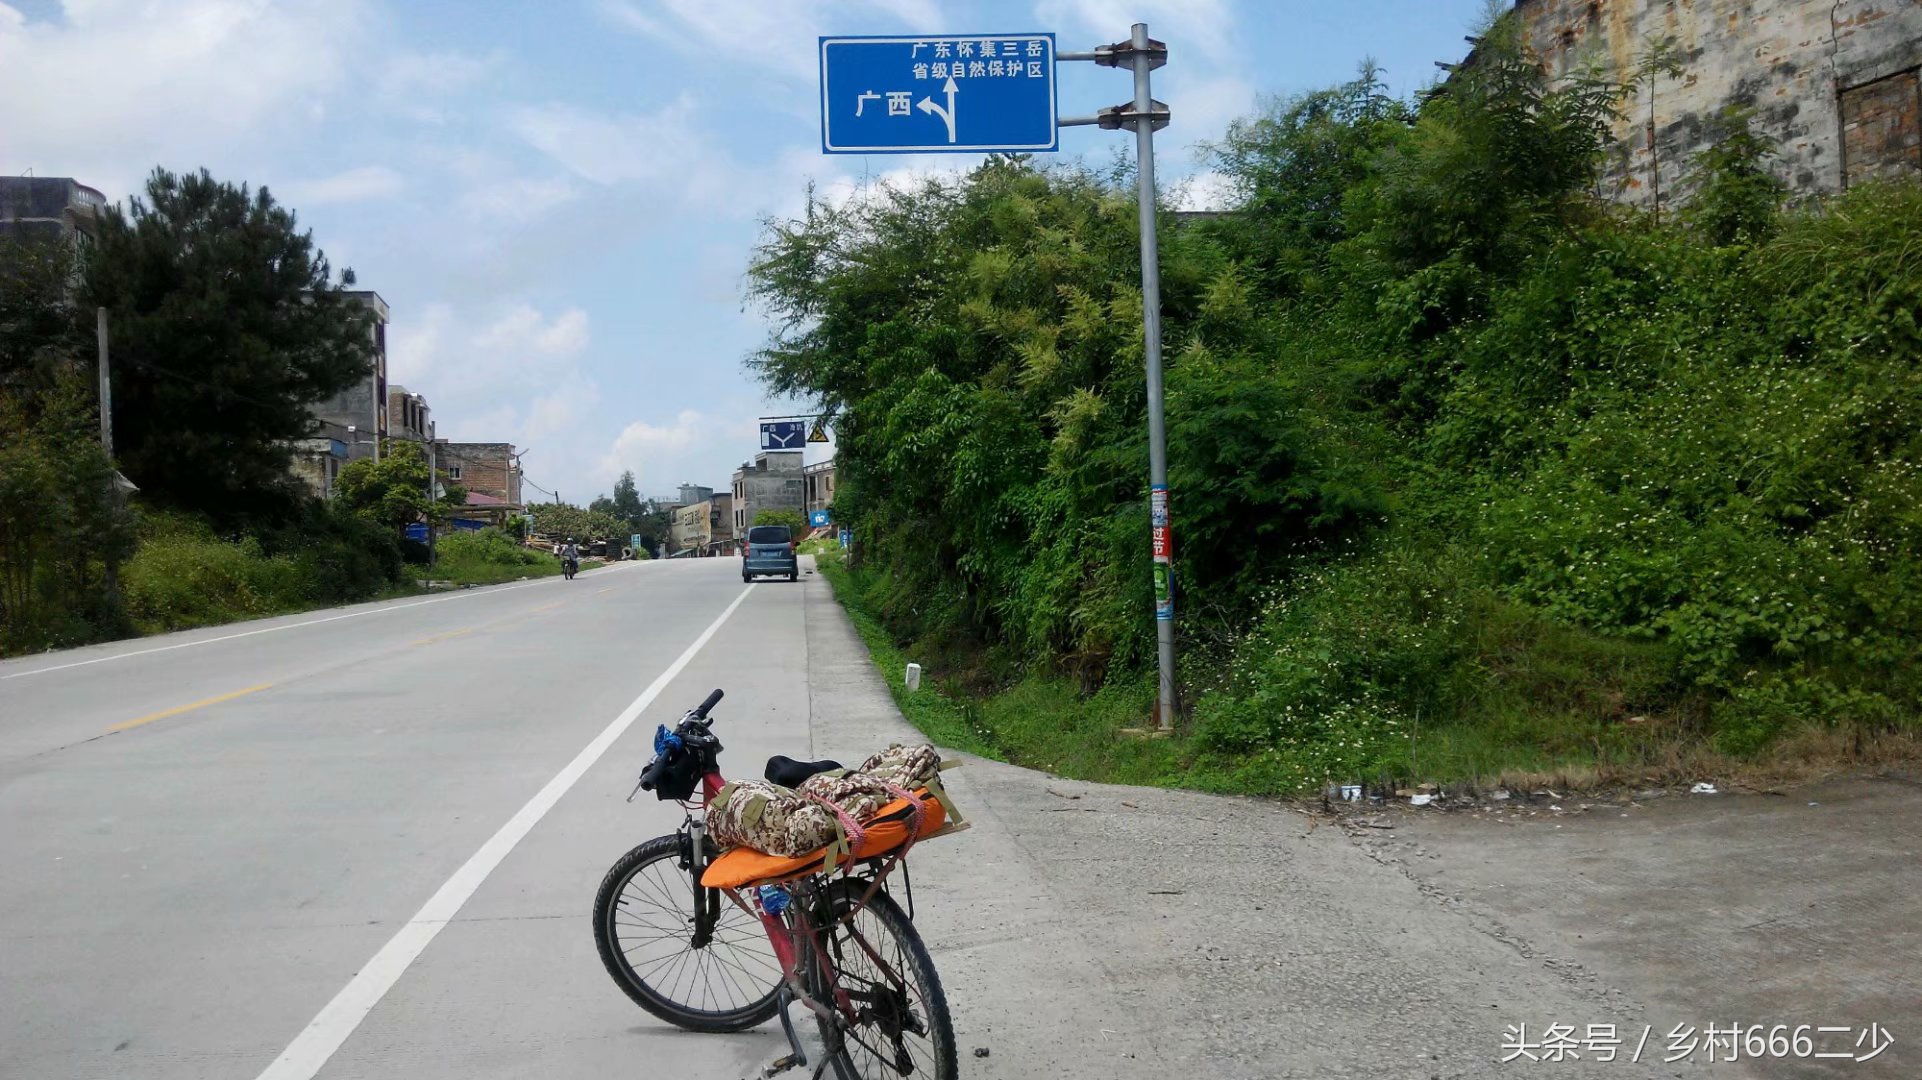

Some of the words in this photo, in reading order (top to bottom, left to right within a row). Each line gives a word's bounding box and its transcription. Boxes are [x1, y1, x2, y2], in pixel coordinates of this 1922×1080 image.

[911, 40, 1044, 59] 广东怀集三岳
[912, 60, 1044, 80] 省级自然保护区
[855, 90, 913, 117] 广西
